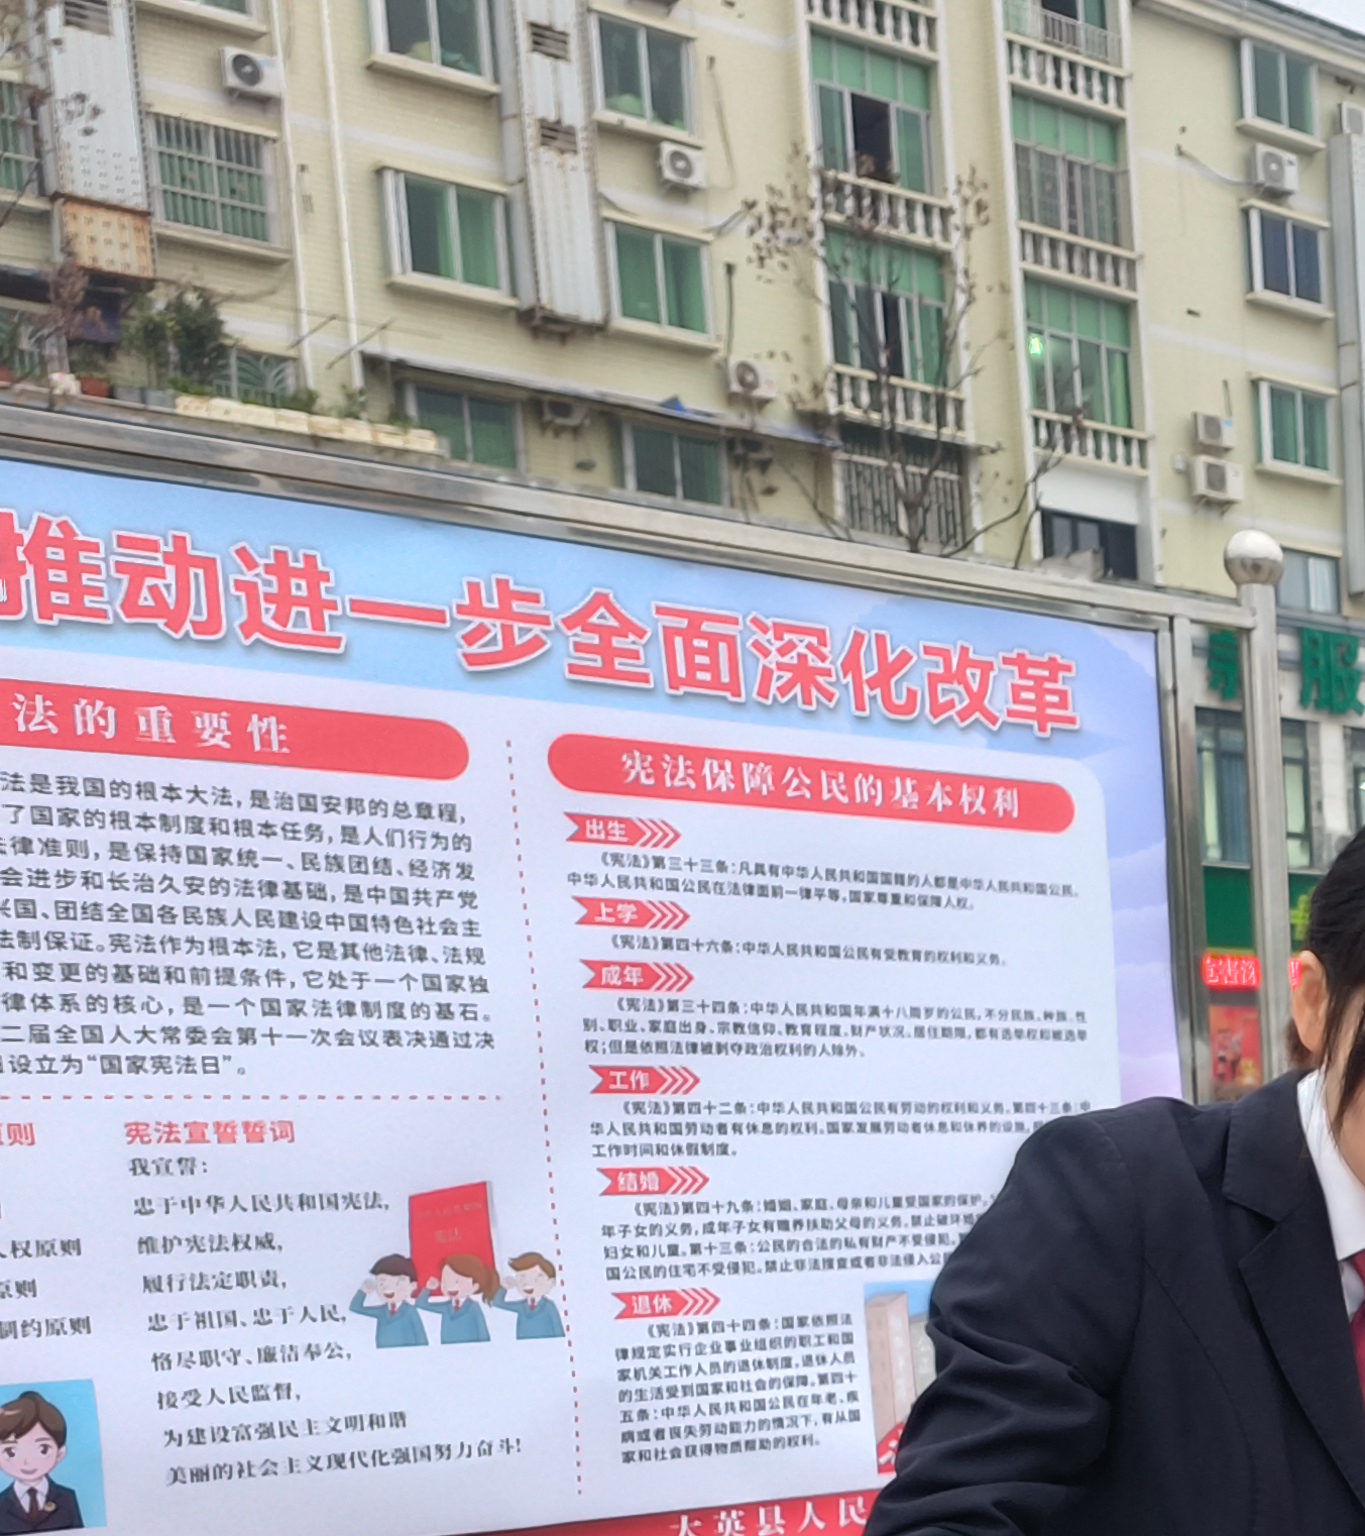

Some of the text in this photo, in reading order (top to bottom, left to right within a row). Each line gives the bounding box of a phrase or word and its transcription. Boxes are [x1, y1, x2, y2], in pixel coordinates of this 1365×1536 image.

[0, 510, 1080, 738] 推动进一步全面深化改革
[621, 750, 1021, 820] 宪法保障公民的基本权利
[585, 818, 629, 843] 出生
[0, 836, 475, 881] 律准则，是保持国家统一、民族团结、经济发
[594, 903, 638, 925] 上学
[600, 964, 644, 987] 成年
[0, 1053, 246, 1076] 设立为“国家宪法日”。
[608, 1069, 650, 1091] 工作
[0, 1122, 36, 1146] 则
[124, 1120, 296, 1146] 宪法宣誓誓词
[129, 1157, 209, 1178] 我宣誓：
[617, 1170, 660, 1193] 结婚
[602, 1212, 982, 1239] 年子女的义务，成年子女有赡养扶助父母的义务。禁止破坏婚
[0, 1237, 82, 1259] 权原则
[632, 1294, 672, 1315] 退休
